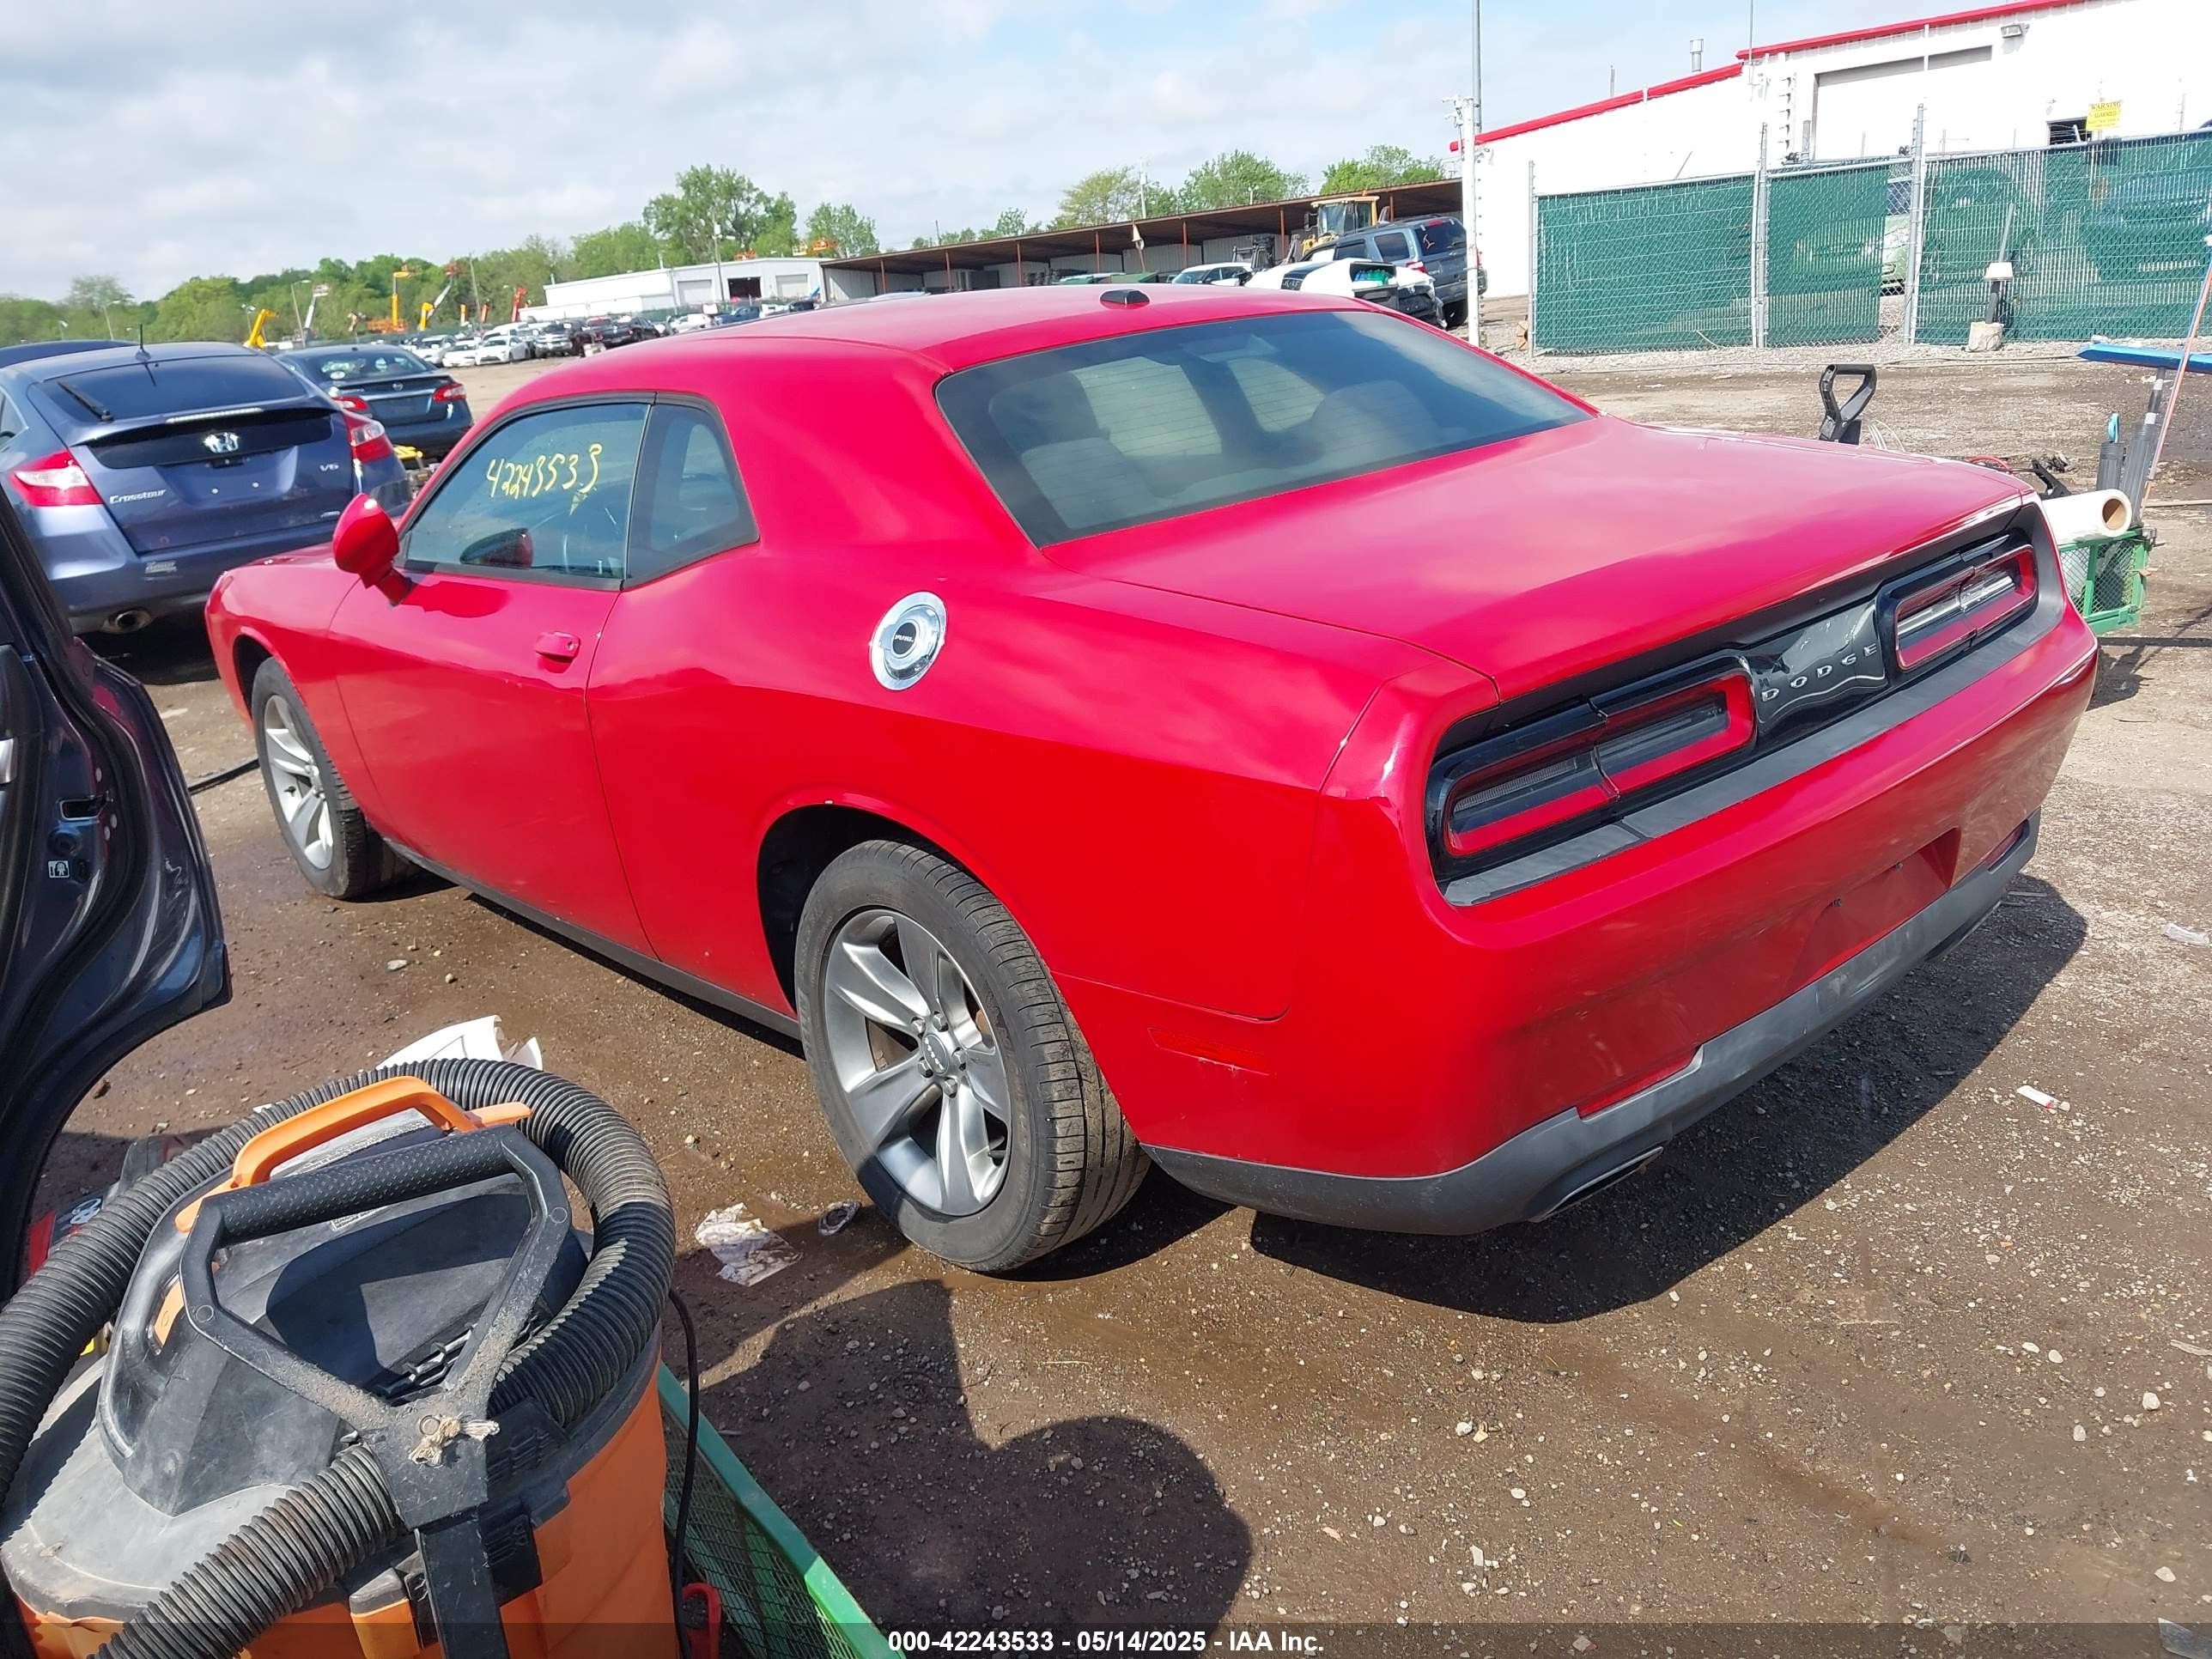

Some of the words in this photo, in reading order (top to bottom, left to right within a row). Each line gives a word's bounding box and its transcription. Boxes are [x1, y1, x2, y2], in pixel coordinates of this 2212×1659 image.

[2090, 101, 2121, 110] WARNING
[319, 464, 340, 472] V6
[109, 489, 167, 505] Crosstour
[1761, 642, 1878, 702] DODGE
